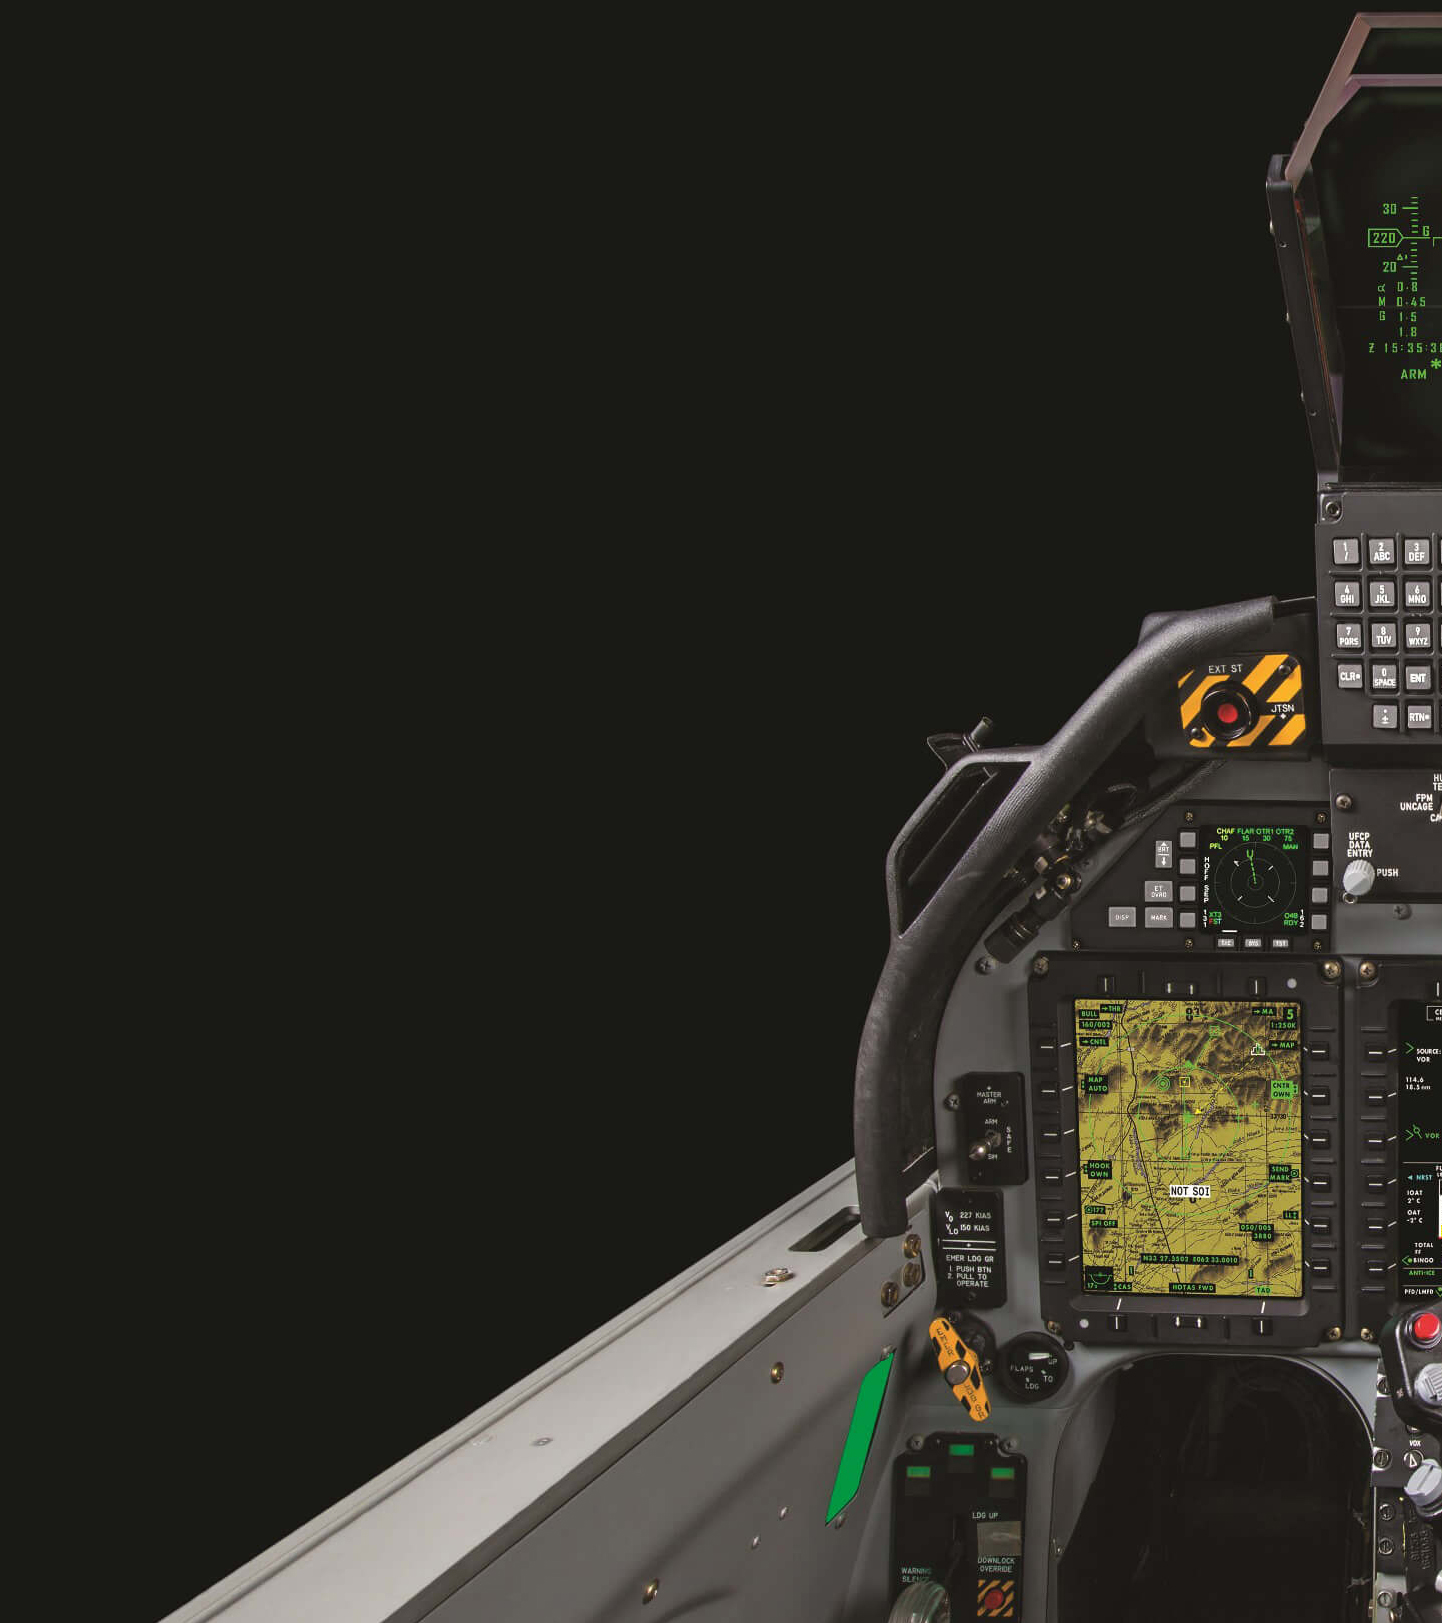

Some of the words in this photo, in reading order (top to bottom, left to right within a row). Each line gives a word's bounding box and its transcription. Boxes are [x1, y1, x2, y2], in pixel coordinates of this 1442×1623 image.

[1383, 204, 1397, 214] 30
[1373, 232, 1396, 244] 220
[1383, 262, 1397, 272] 20
[1401, 369, 1427, 380] ARM
[1374, 552, 1390, 560] ABC
[1409, 552, 1425, 560] DEF
[1375, 595, 1390, 603] JKL
[1376, 636, 1392, 645] TUV
[1409, 637, 1428, 645] WXYZ
[1208, 664, 1226, 674] EXT
[1231, 664, 1242, 673] ST
[1410, 674, 1426, 683] ENT
[1271, 704, 1294, 713] JTSN
[1416, 794, 1433, 802] FPM
[1400, 802, 1433, 811] UNCAGE
[1349, 832, 1370, 841] UFCP
[1349, 841, 1371, 849] DATA
[1347, 849, 1373, 858] ENTRY
[1377, 868, 1398, 877] PUSH
[1171, 1187, 1188, 1196] NOT
[1193, 1187, 1210, 1196] SOI
